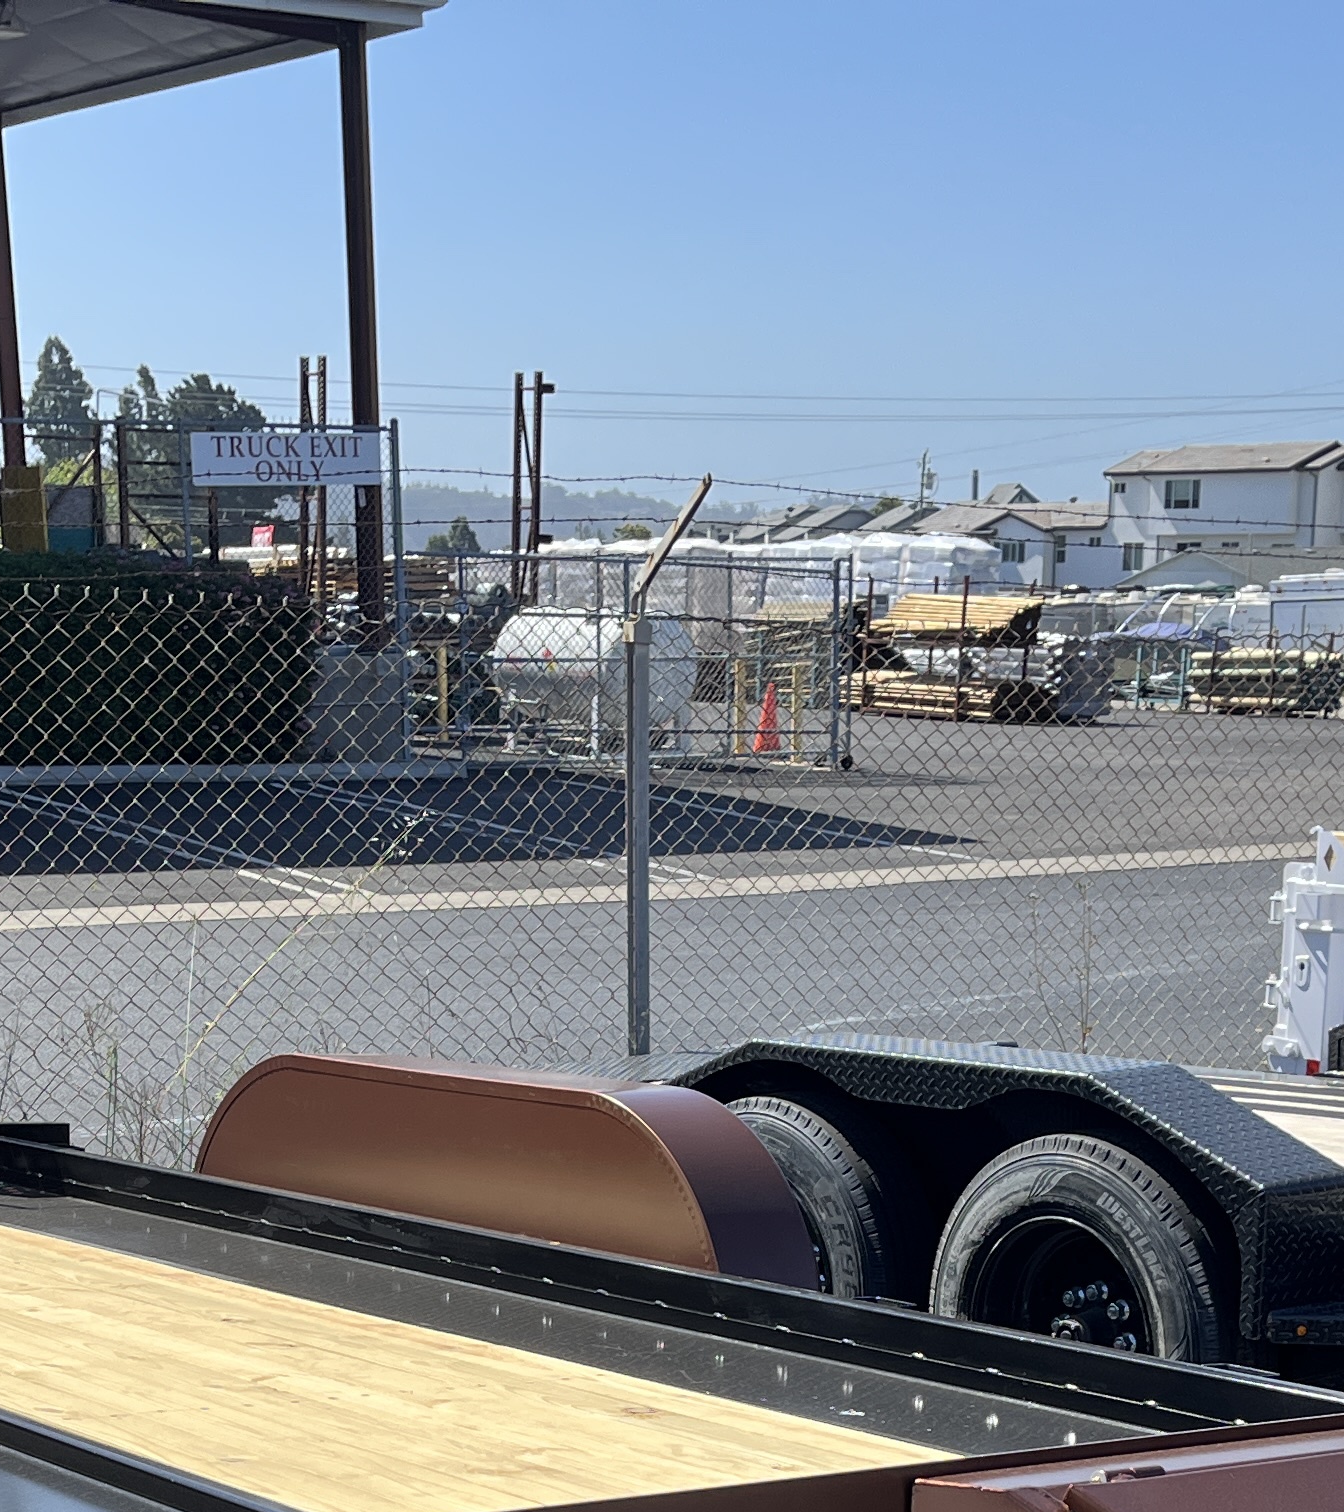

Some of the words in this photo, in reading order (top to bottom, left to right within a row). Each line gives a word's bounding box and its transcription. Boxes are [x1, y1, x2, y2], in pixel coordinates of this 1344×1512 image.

[211, 436, 301, 458] TRUCK
[310, 436, 363, 458] EXIT
[256, 460, 325, 482] ONLY
[1096, 1191, 1170, 1292] WESTLAKE
